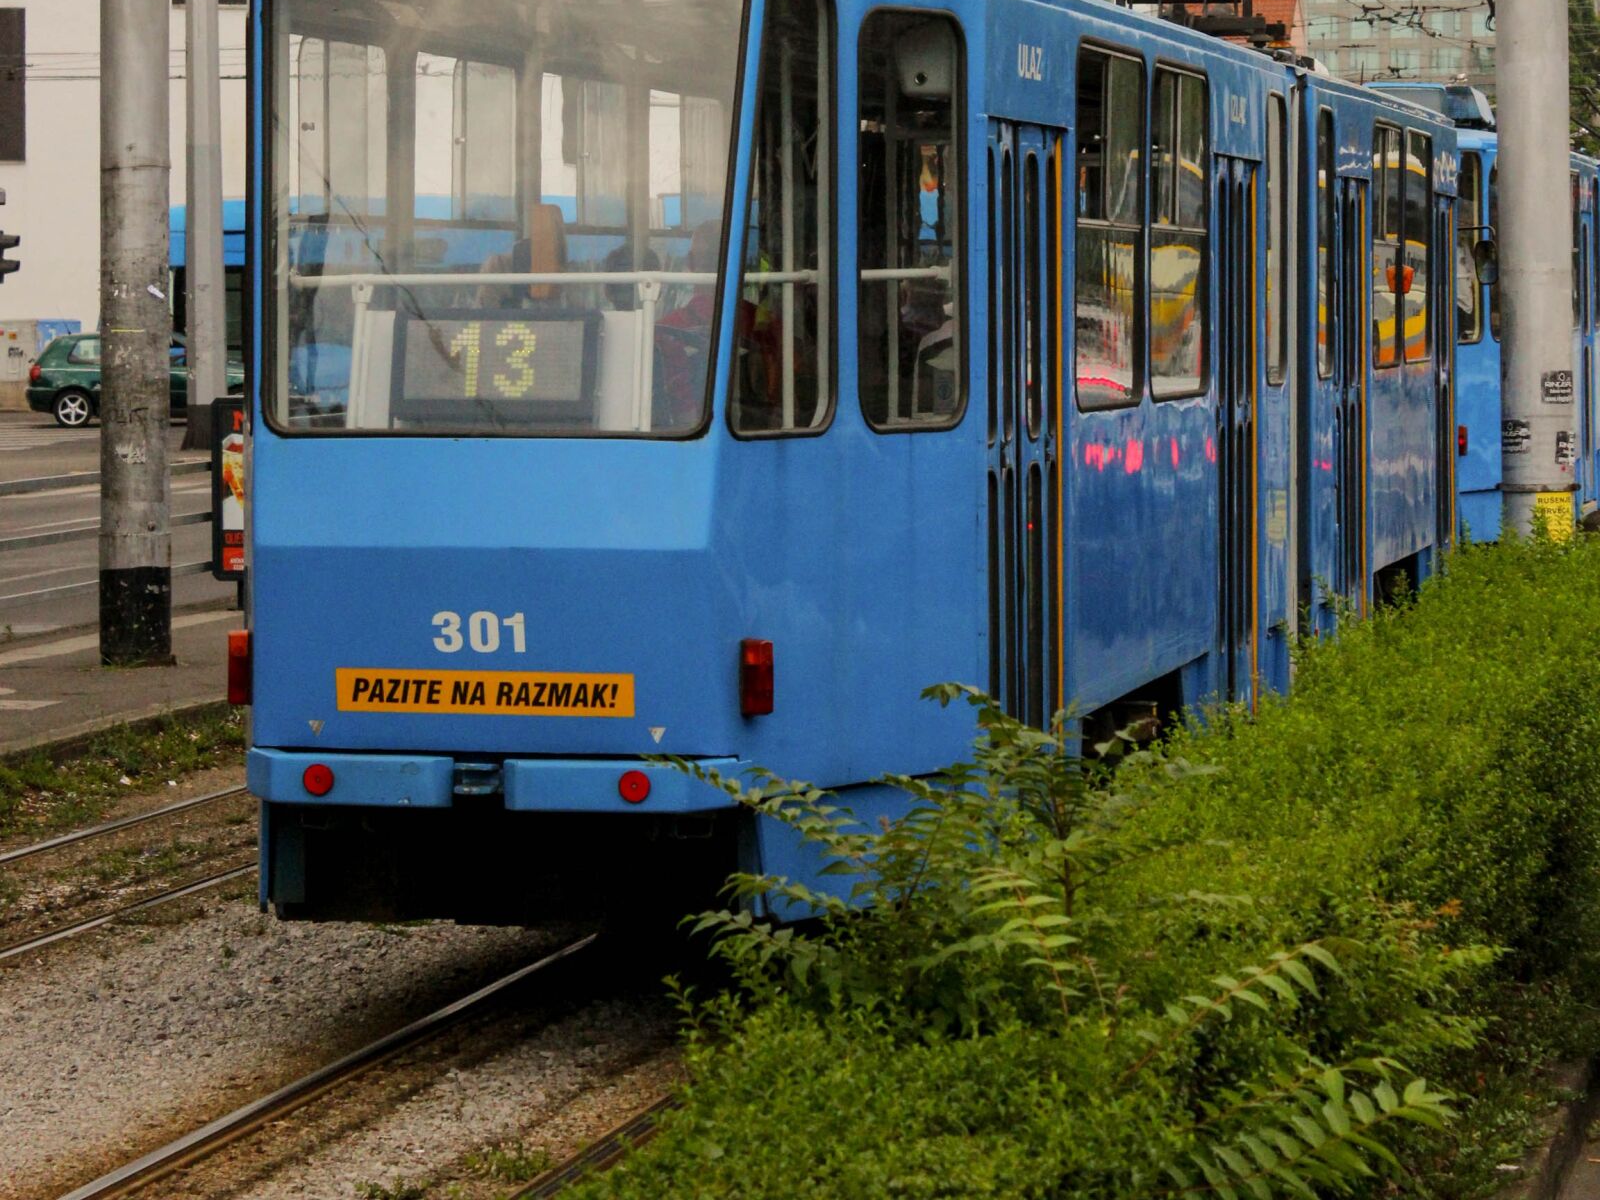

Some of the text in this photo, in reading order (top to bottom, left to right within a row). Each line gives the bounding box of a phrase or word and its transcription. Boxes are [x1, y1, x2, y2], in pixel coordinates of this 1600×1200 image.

[1017, 43, 1042, 81] ULAZ
[450, 322, 536, 397] 13
[431, 611, 526, 653] 301
[352, 678, 619, 708] PAZITE NA RAZMAK!
